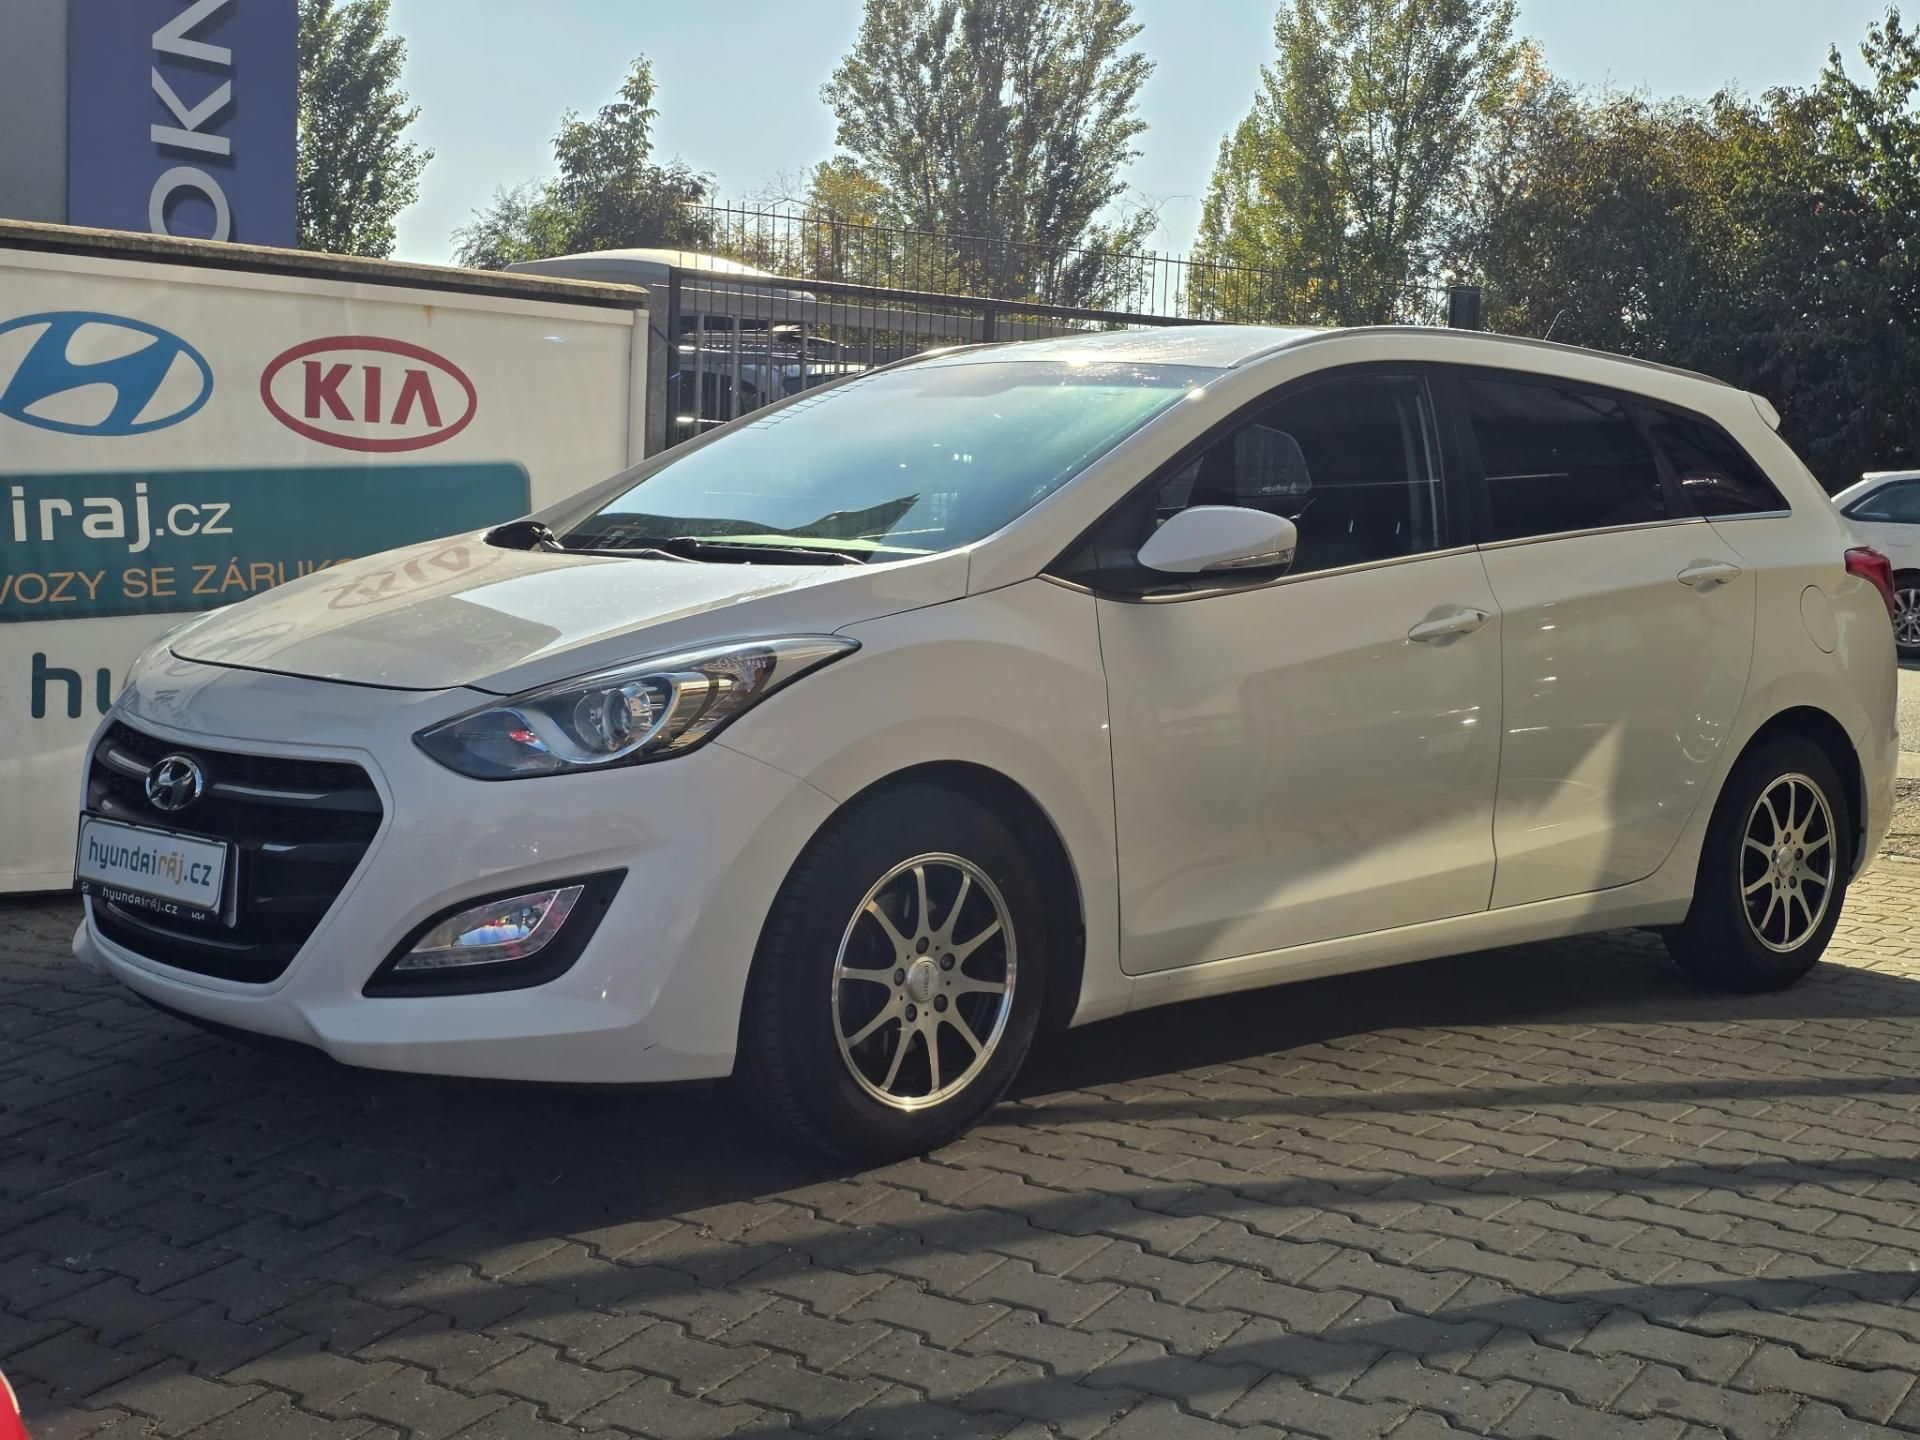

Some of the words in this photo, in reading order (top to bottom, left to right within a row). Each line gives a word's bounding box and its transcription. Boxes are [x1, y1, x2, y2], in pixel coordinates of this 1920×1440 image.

[302, 361, 443, 428] KIA
[11, 482, 234, 553] iraj.cz
[122, 567, 177, 598] SE
